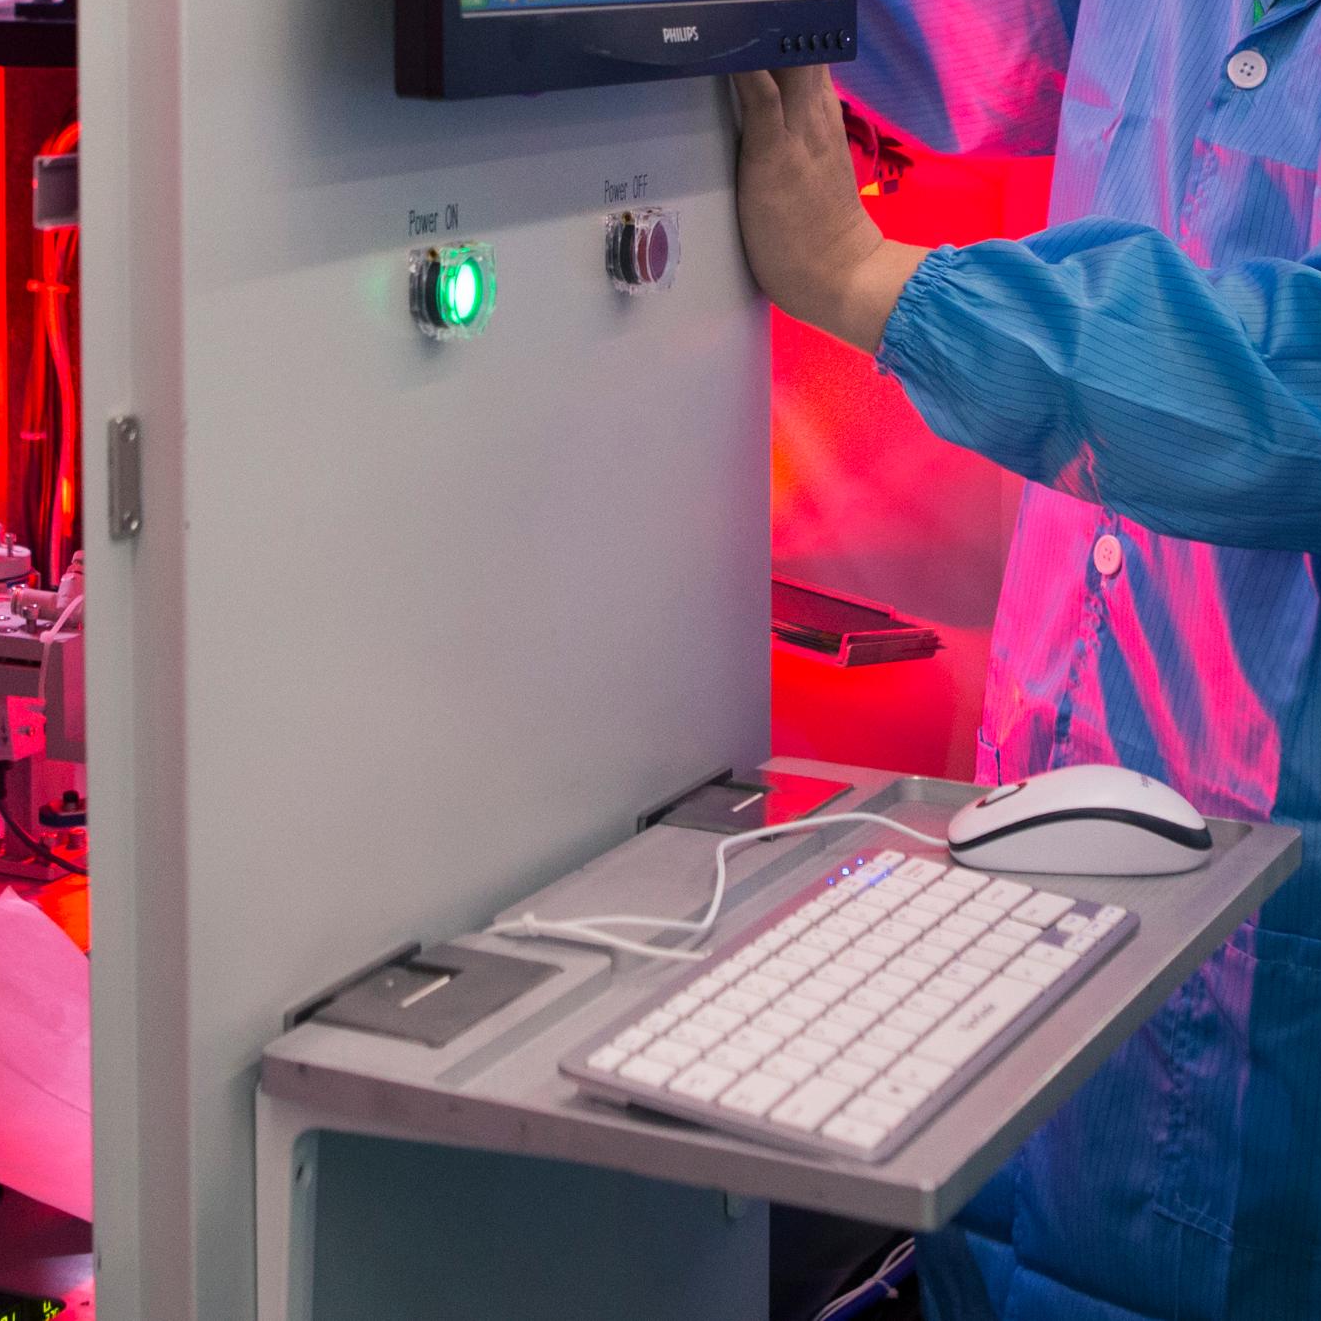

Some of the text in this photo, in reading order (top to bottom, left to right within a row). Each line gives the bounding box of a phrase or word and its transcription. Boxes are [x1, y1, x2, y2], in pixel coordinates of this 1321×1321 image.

[662, 26, 699, 43] PHILIPS
[604, 174, 648, 204] Power OFF
[408, 203, 459, 237] Power ON
